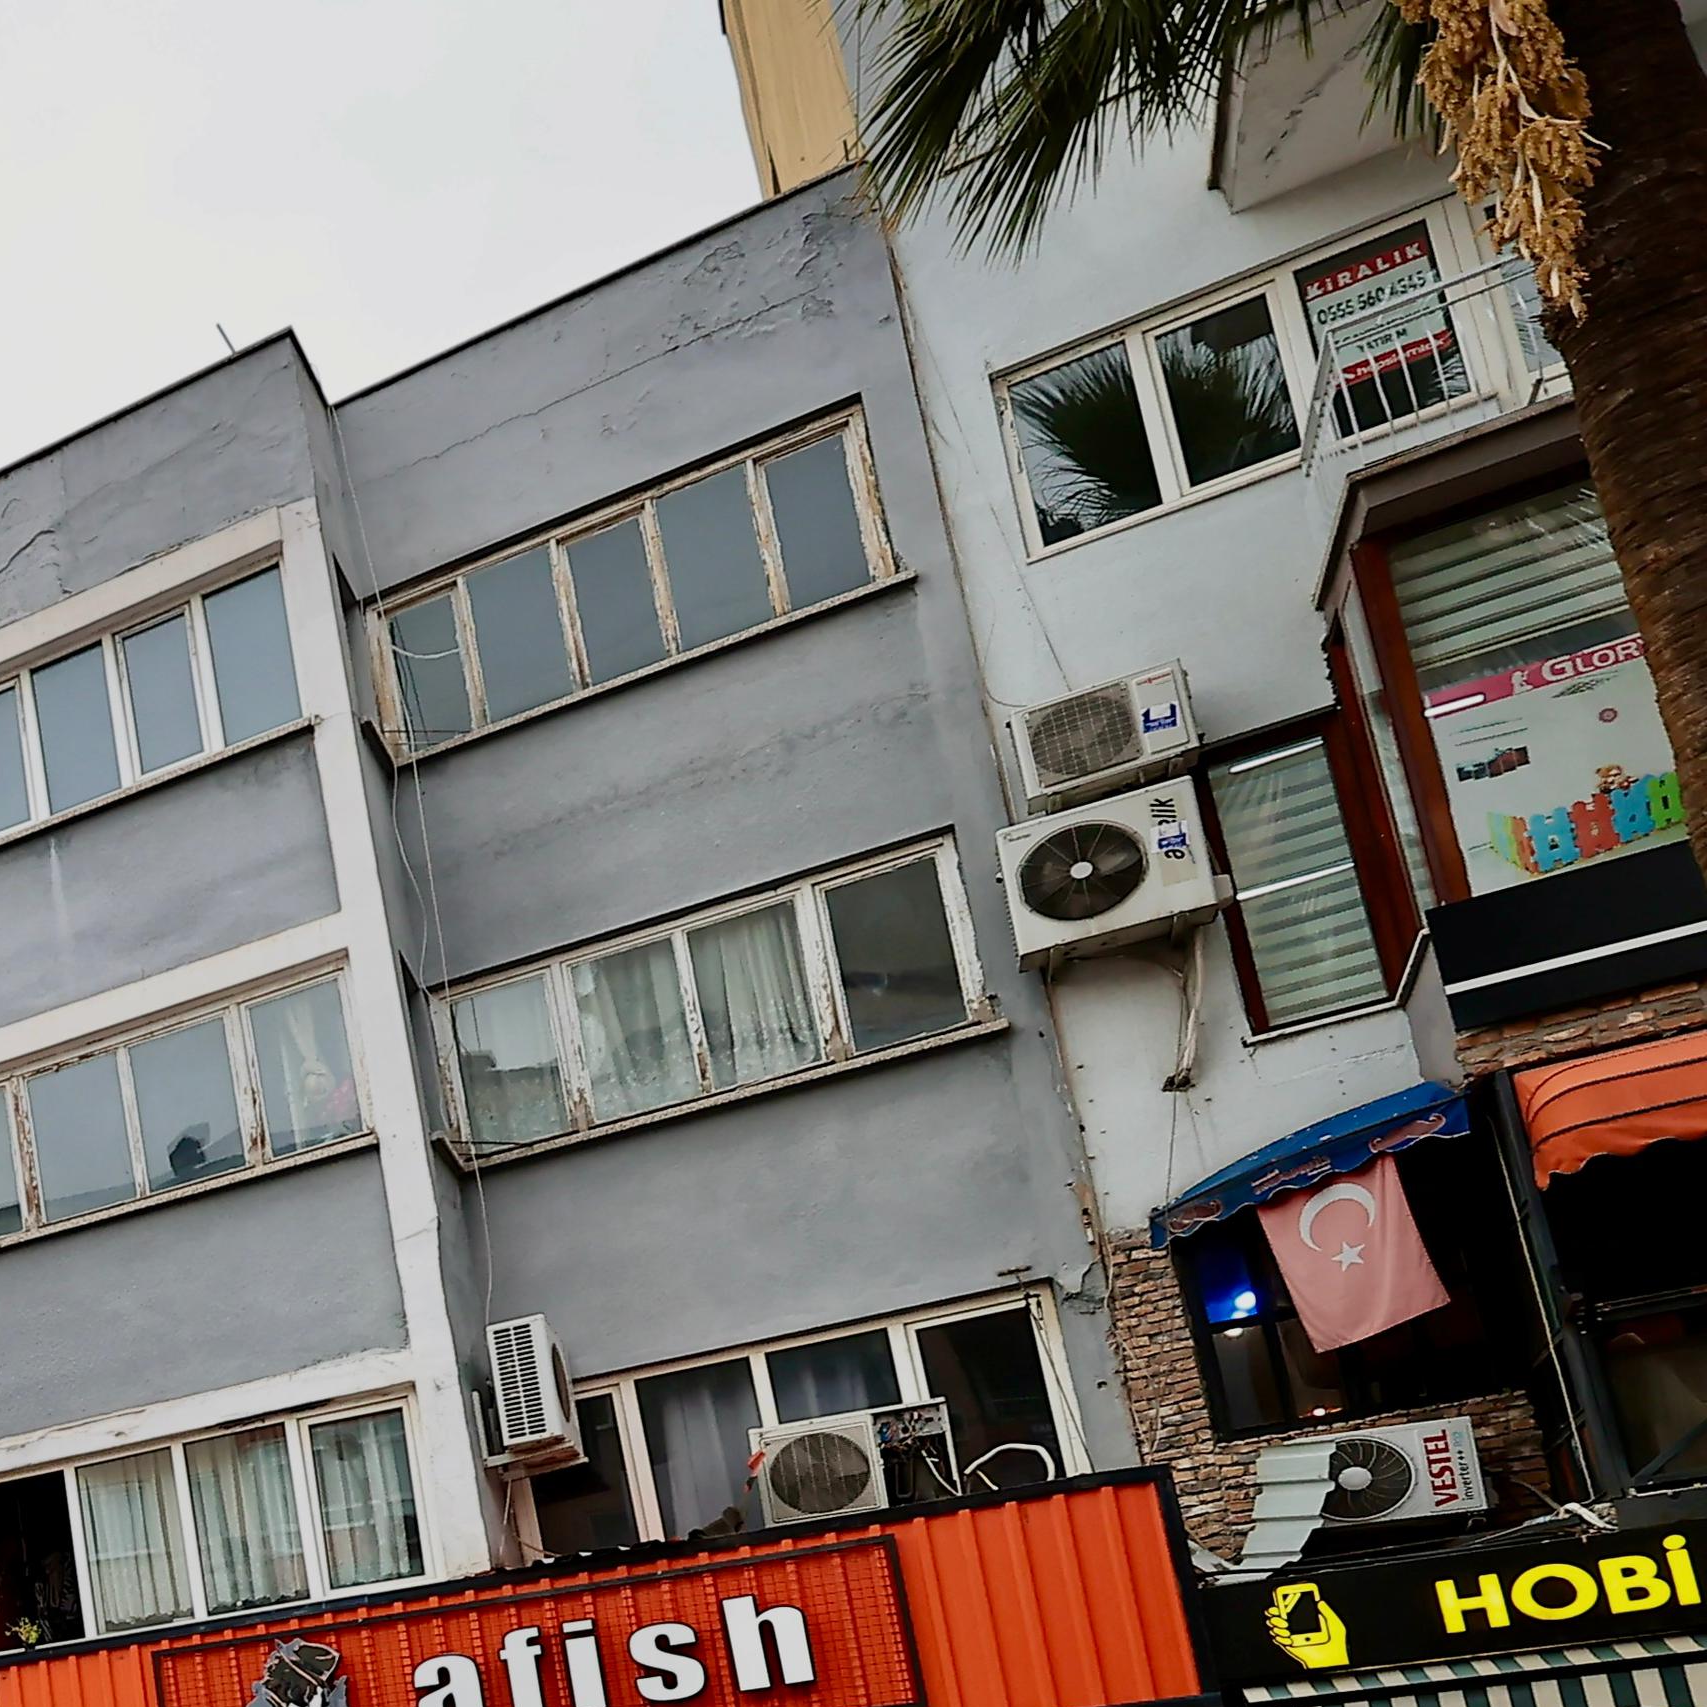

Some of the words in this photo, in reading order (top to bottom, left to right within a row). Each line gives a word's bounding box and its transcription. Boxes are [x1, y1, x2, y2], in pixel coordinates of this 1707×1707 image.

[1317, 299, 1354, 325] 0555
[1357, 328, 1408, 352] YATIRM
[1540, 638, 1645, 683] GLOR
[1150, 797, 1187, 860] alik
[1423, 1428, 1460, 1508] VESTEL
[1435, 1533, 1703, 1635] HOBİ
